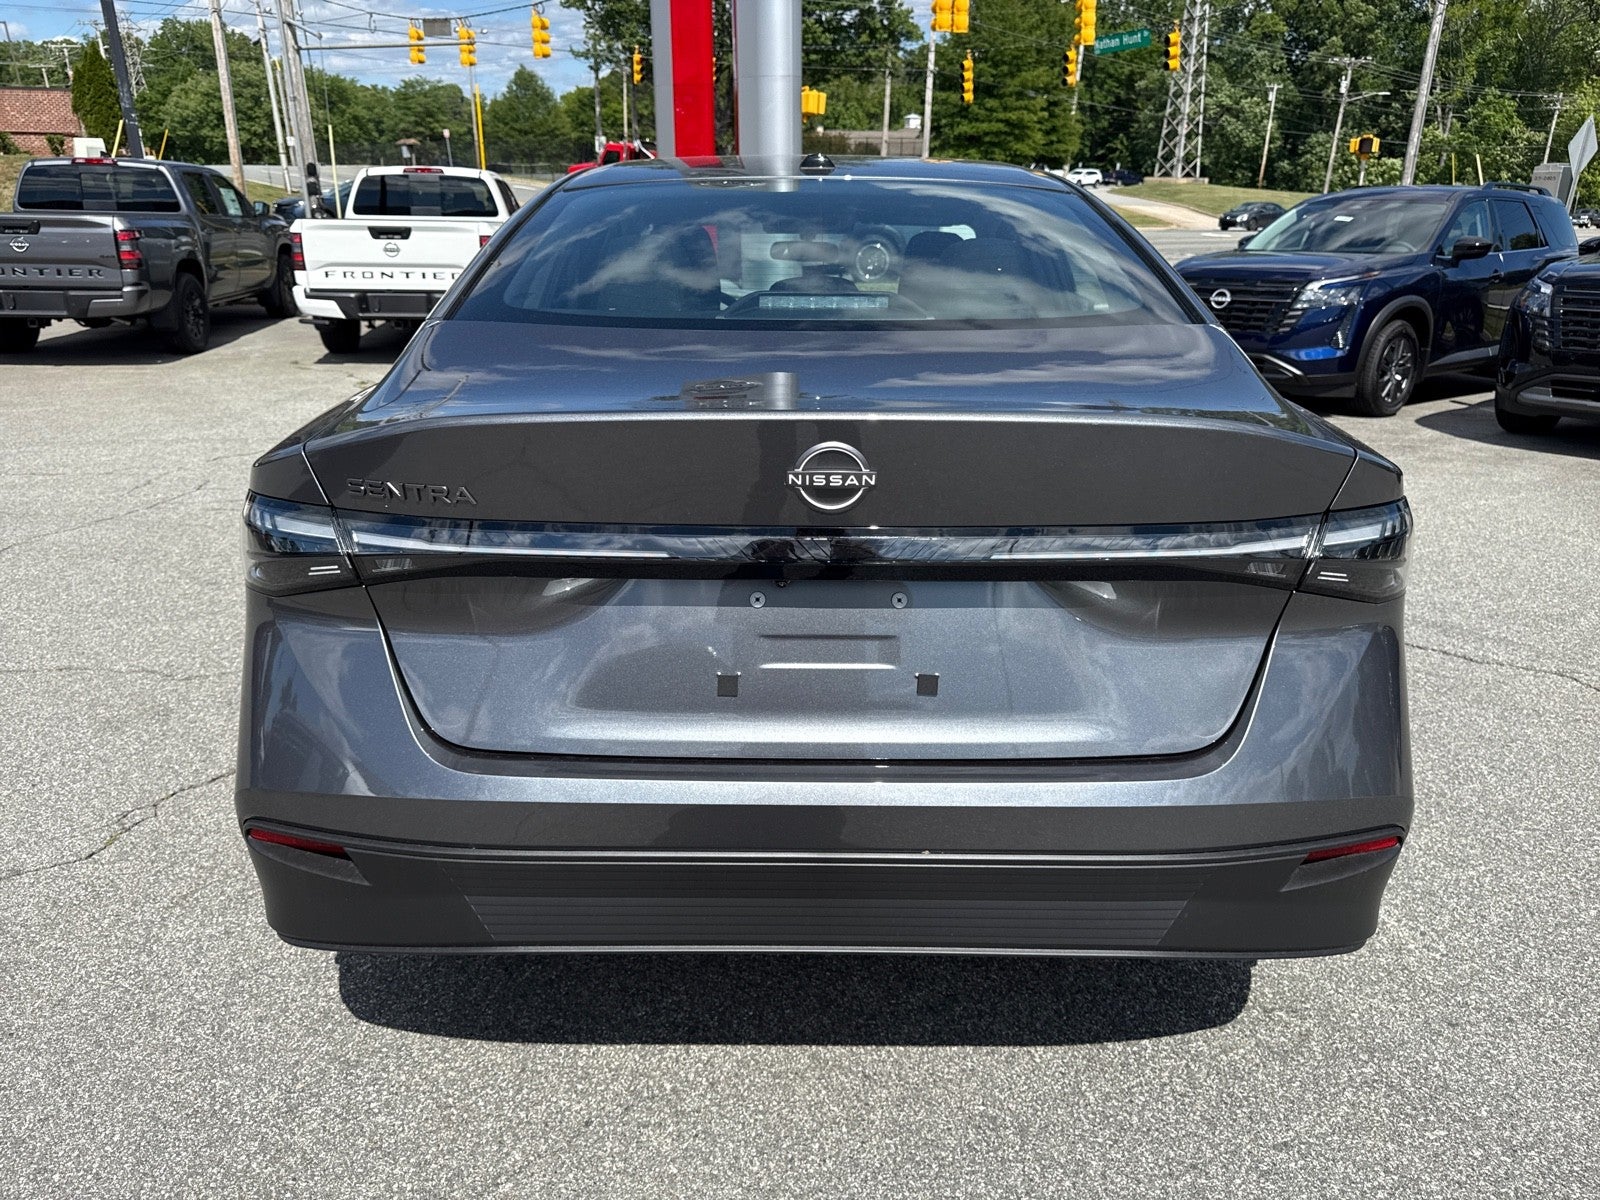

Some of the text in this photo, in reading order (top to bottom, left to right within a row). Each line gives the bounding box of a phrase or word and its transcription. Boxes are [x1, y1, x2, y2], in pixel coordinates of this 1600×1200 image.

[1094, 37, 1120, 50] Nathan
[1122, 31, 1142, 45] Hunt
[788, 473, 876, 487] NISSAN
[346, 478, 477, 505] SENTRA
